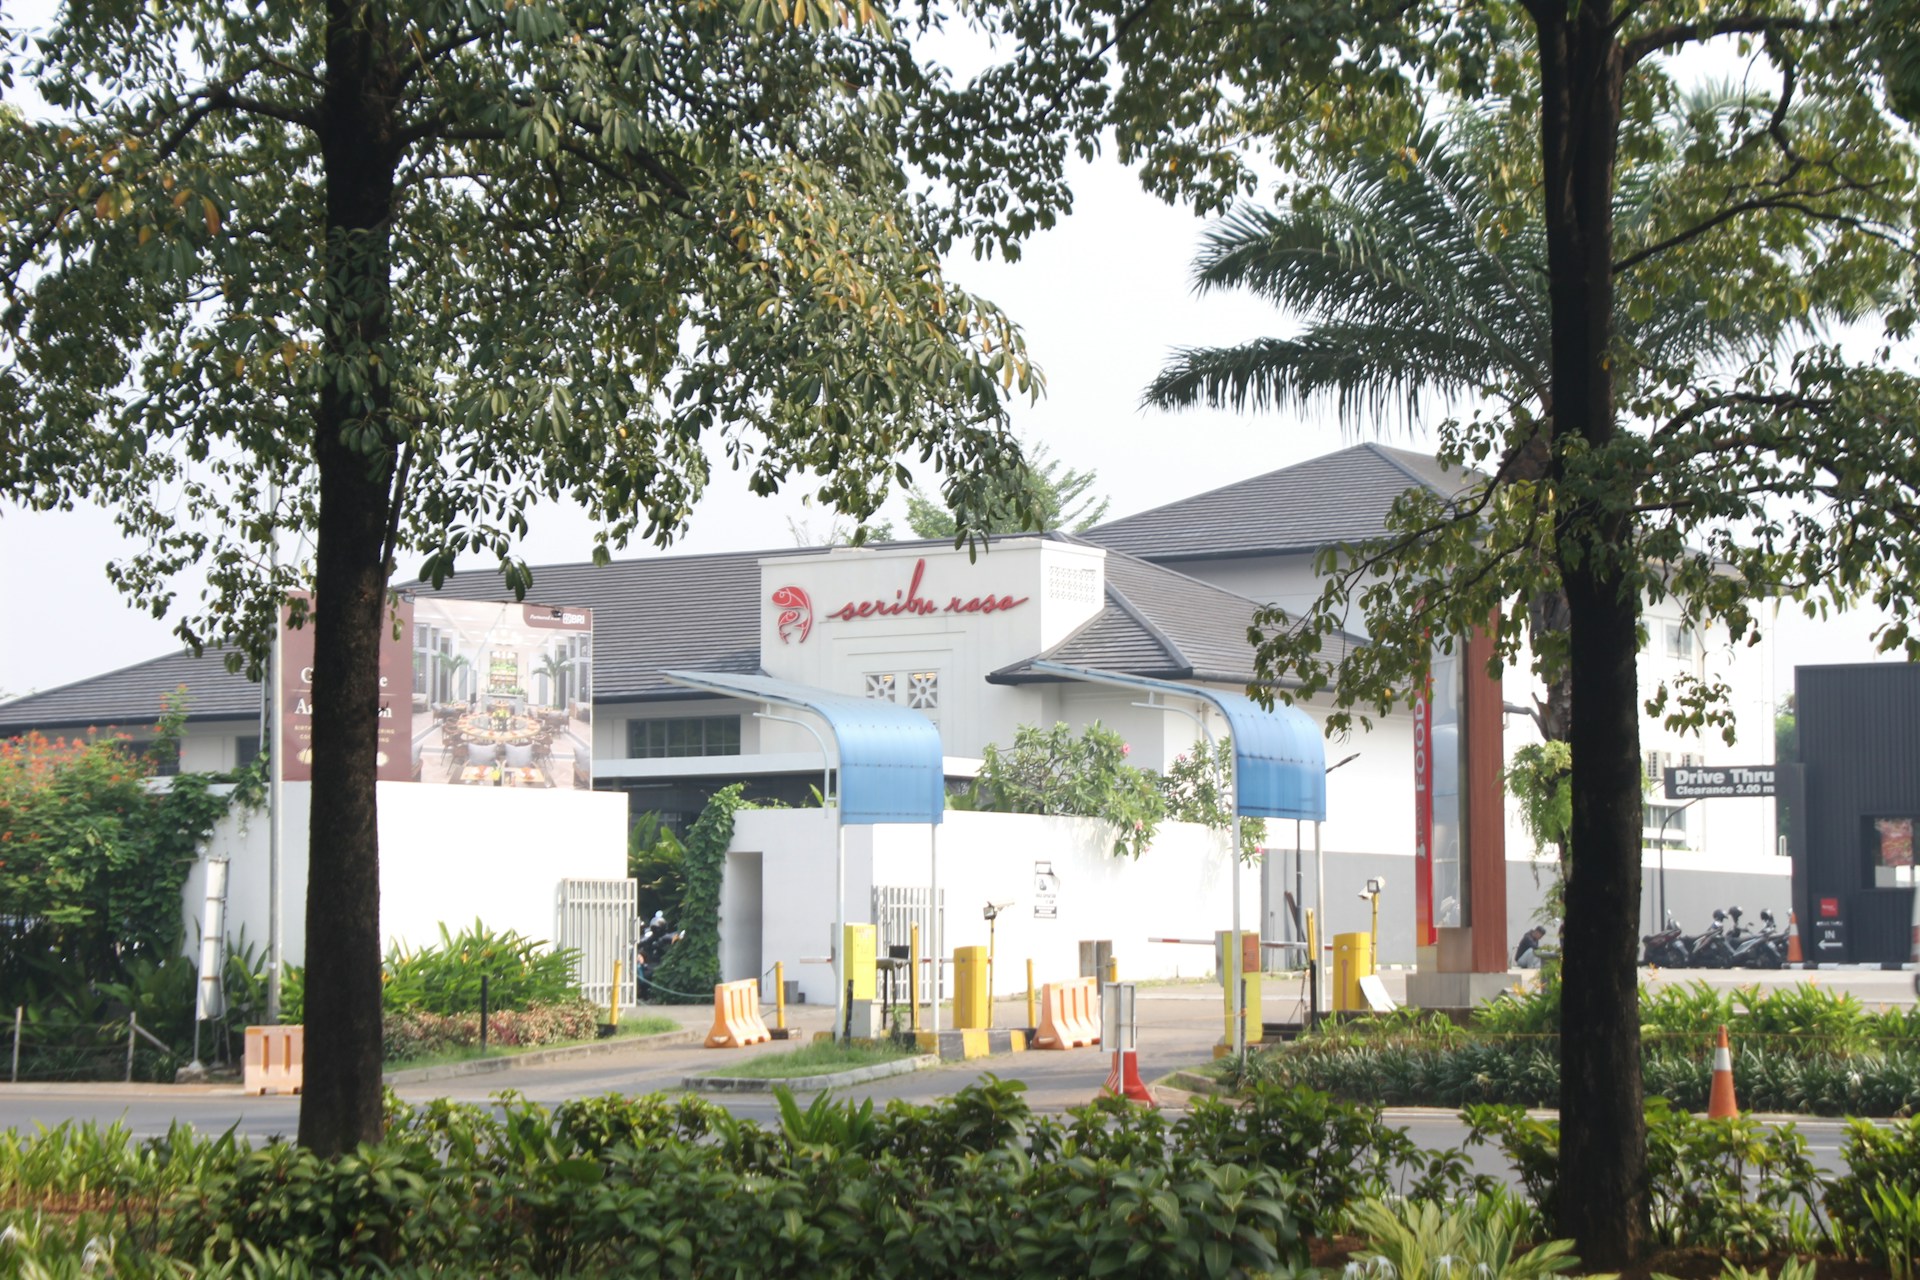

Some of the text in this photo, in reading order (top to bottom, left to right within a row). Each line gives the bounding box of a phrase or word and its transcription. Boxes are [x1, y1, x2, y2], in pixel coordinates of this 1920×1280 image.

[827, 558, 1029, 620] seribu rasa
[572, 614, 585, 624] BRI
[1415, 697, 1425, 791] FOOD
[1675, 769, 1774, 784] Drive Thru
[1676, 784, 1775, 795] Clearance 3.00 m
[1824, 930, 1836, 939] IN
